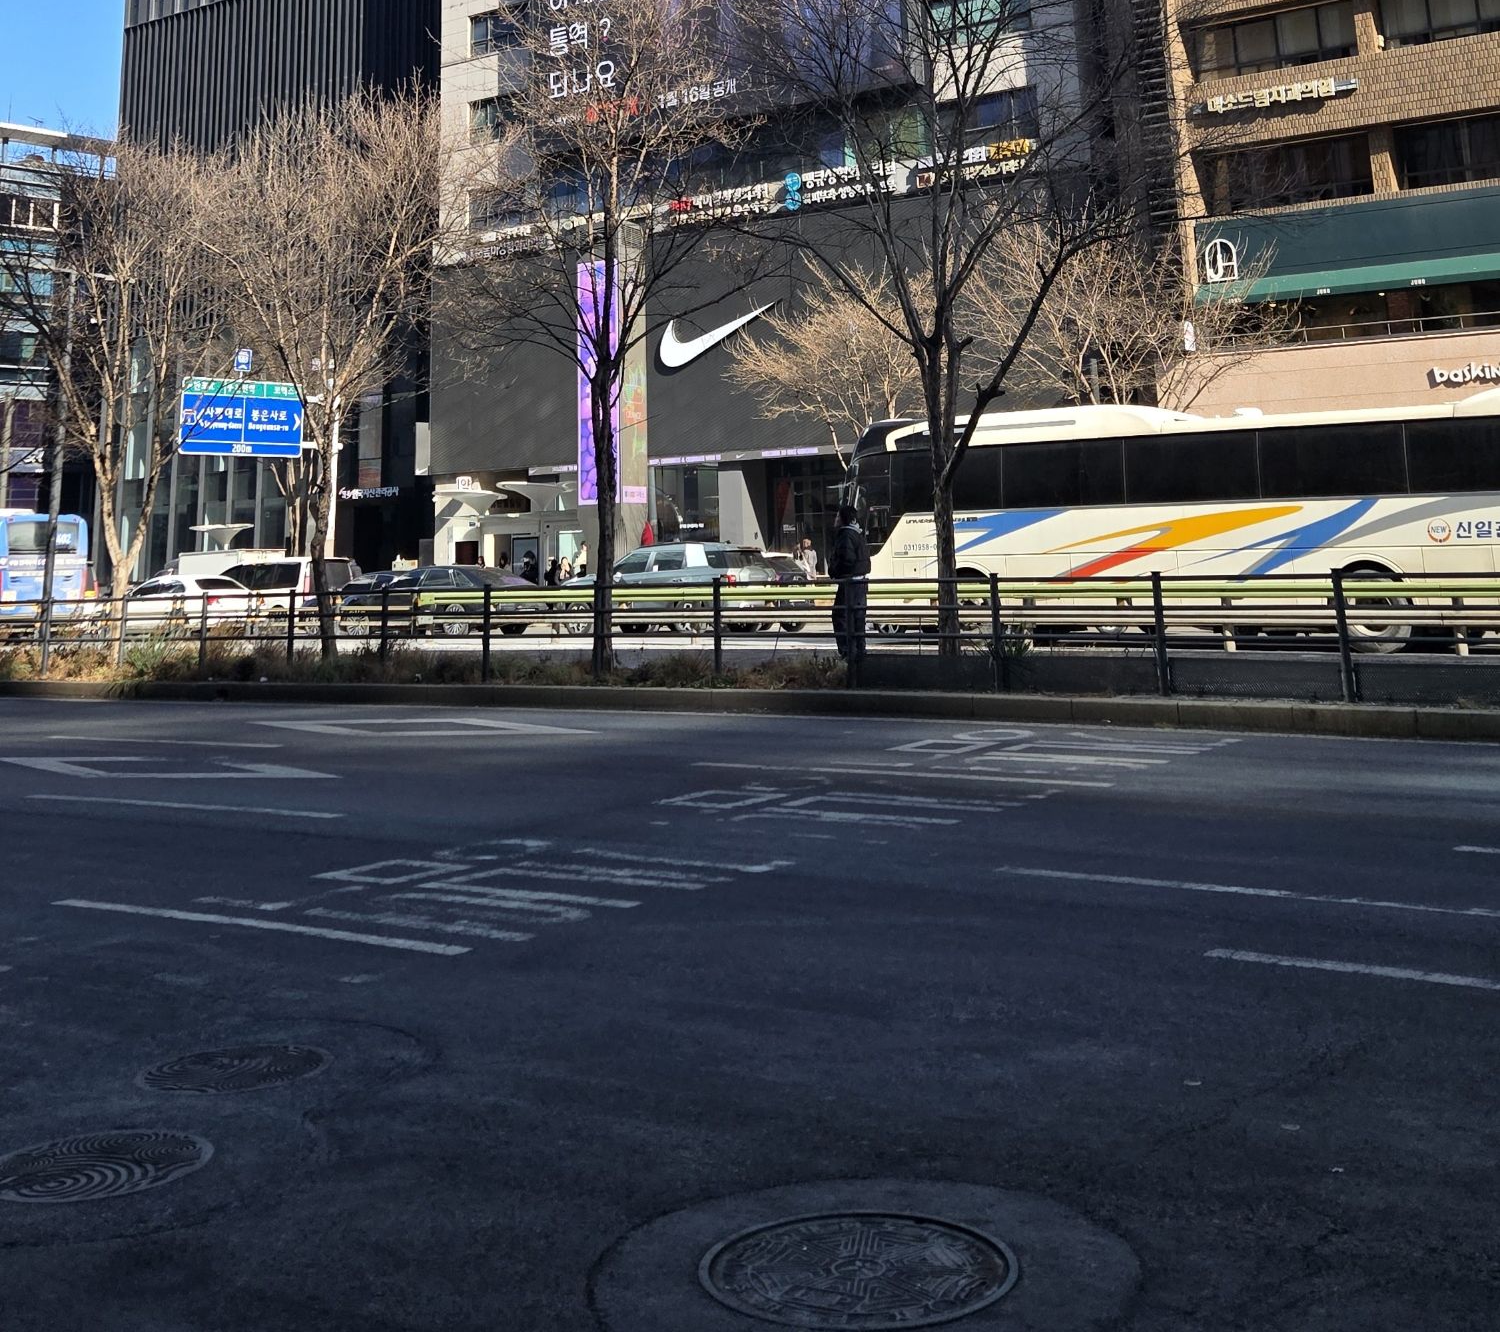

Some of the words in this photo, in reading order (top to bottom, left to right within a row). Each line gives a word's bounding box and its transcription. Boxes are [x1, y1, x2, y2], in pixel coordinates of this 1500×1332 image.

[549, 22, 588, 57] 통역
[549, 60, 616, 99] 되나요
[713, 78, 737, 98] 공개
[1206, 77, 1336, 114] 미소드림치과의원
[801, 159, 896, 189] 땡큐성형외의원
[250, 409, 288, 422] 봉은사로
[231, 443, 253, 453] 200m
[1430, 525, 1448, 534] NEW
[652, 776, 1064, 844] 강남
